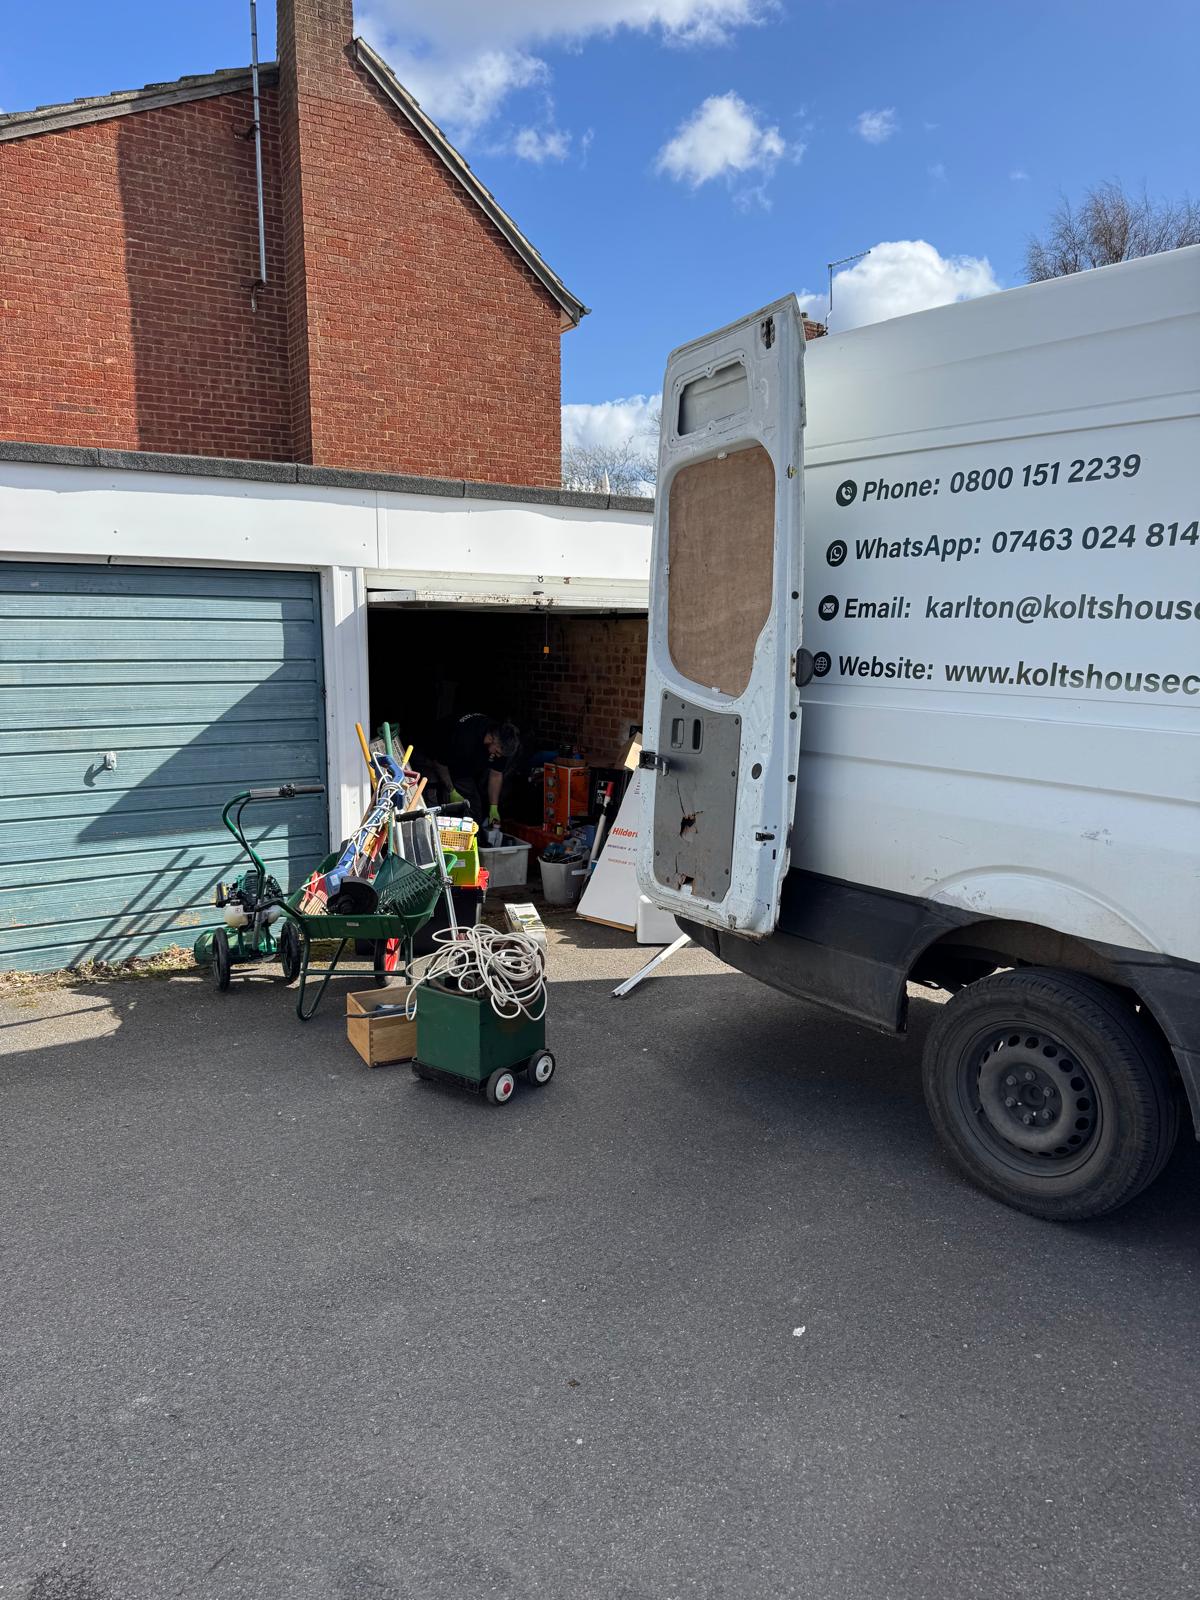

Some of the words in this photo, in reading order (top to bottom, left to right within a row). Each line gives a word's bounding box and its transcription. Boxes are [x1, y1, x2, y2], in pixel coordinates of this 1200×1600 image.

[862, 478, 941, 503] Phone:
[949, 466, 1014, 494] 0800
[1022, 461, 1061, 488] 151
[1067, 453, 1142, 484] 2239
[855, 534, 982, 563] WhatsApp:
[991, 527, 1073, 554] 07463
[1081, 524, 1137, 550] 024
[1145, 520, 1200, 548] 814
[843, 596, 911, 619] Email:
[838, 655, 934, 681] Website:
